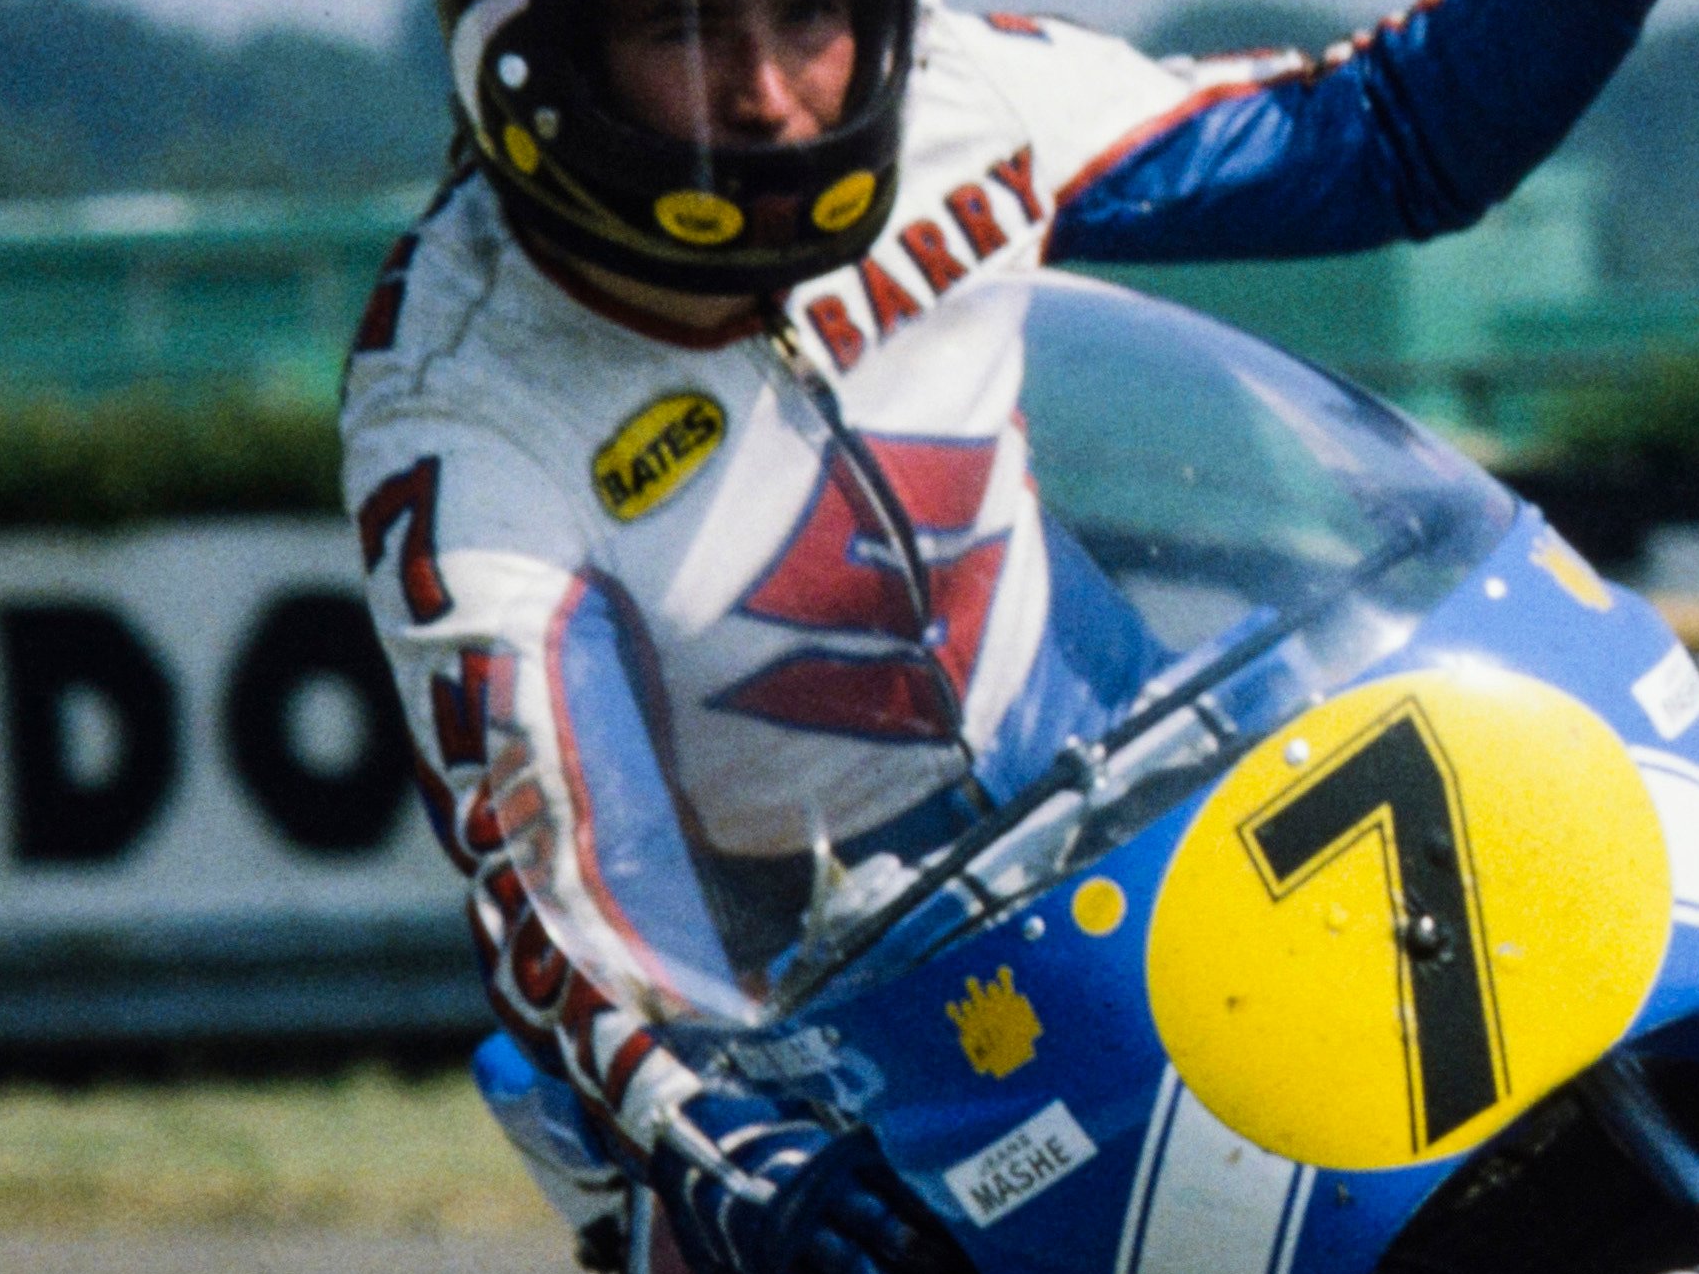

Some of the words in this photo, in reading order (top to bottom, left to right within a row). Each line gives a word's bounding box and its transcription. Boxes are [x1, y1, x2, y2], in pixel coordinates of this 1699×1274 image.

[805, 142, 1047, 373] BARRY
[357, 455, 453, 625] 7
[601, 403, 720, 511] BATES
[1236, 695, 1511, 1153] 7
[970, 1136, 1071, 1216] MASHE
